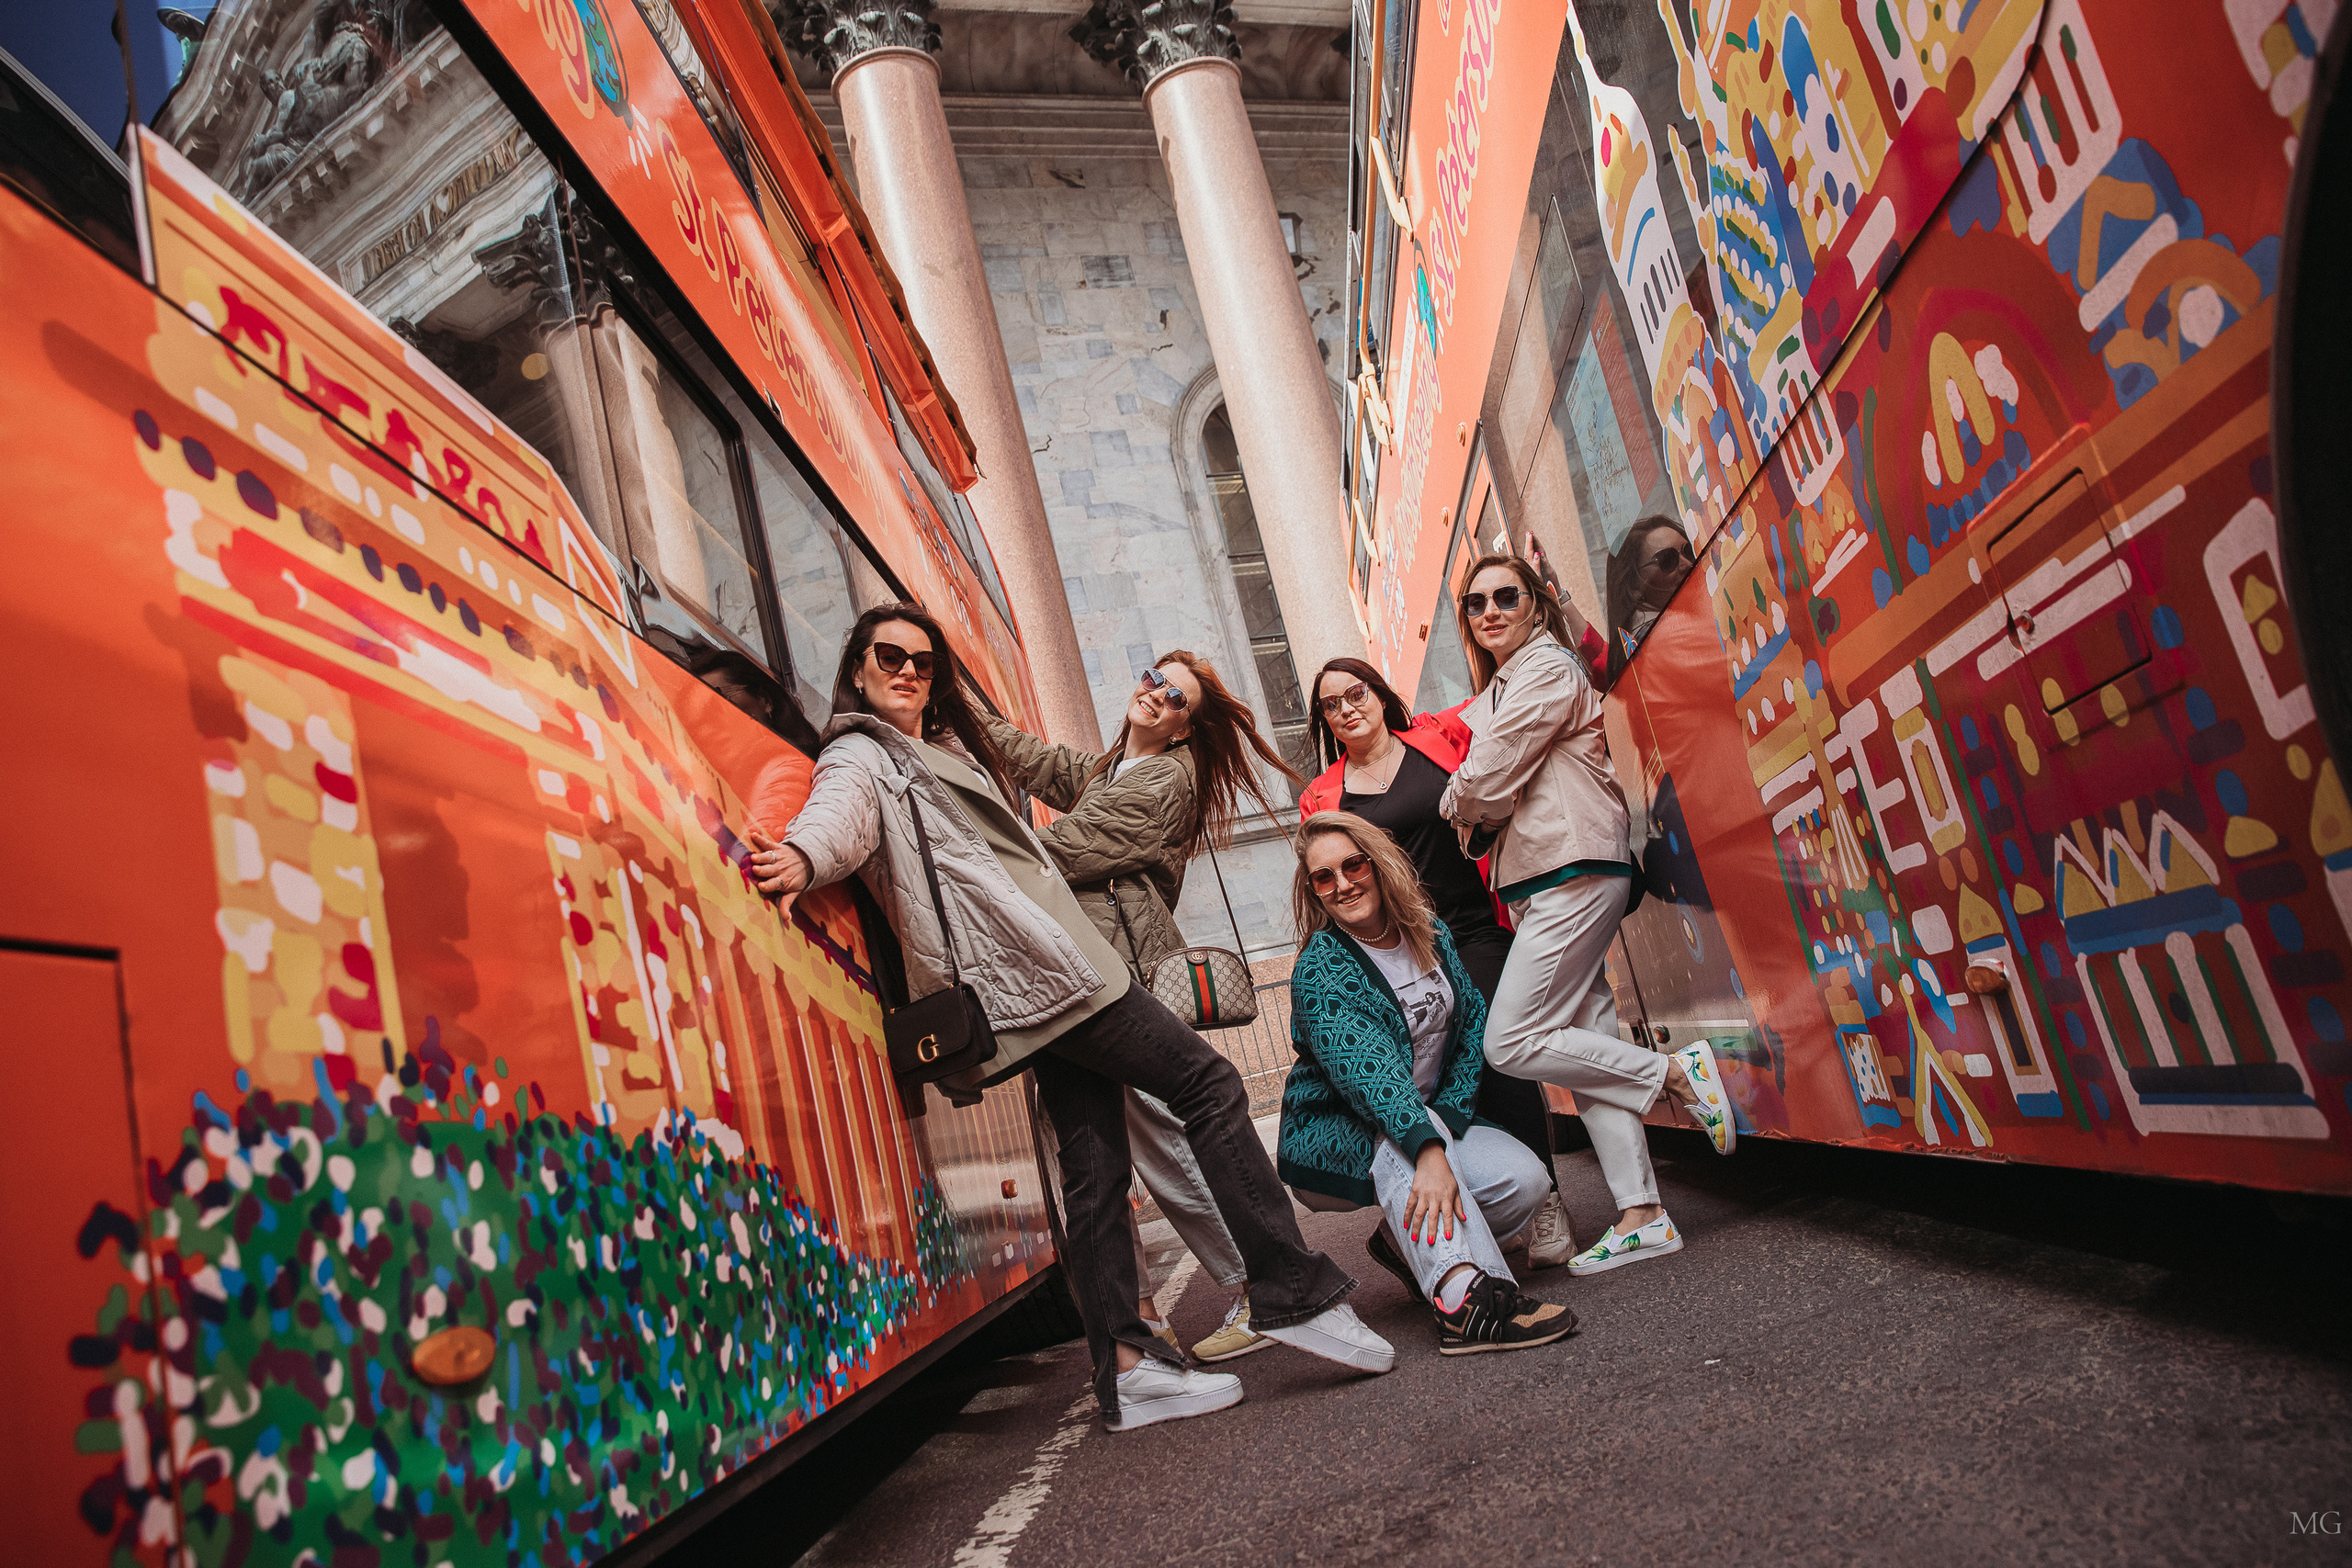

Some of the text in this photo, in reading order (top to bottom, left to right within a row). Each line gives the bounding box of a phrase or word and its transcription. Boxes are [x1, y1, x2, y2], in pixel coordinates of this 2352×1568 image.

[656, 118, 720, 283] St
[917, 1033, 940, 1063] G
[1472, 1275, 1484, 1289] adidas
